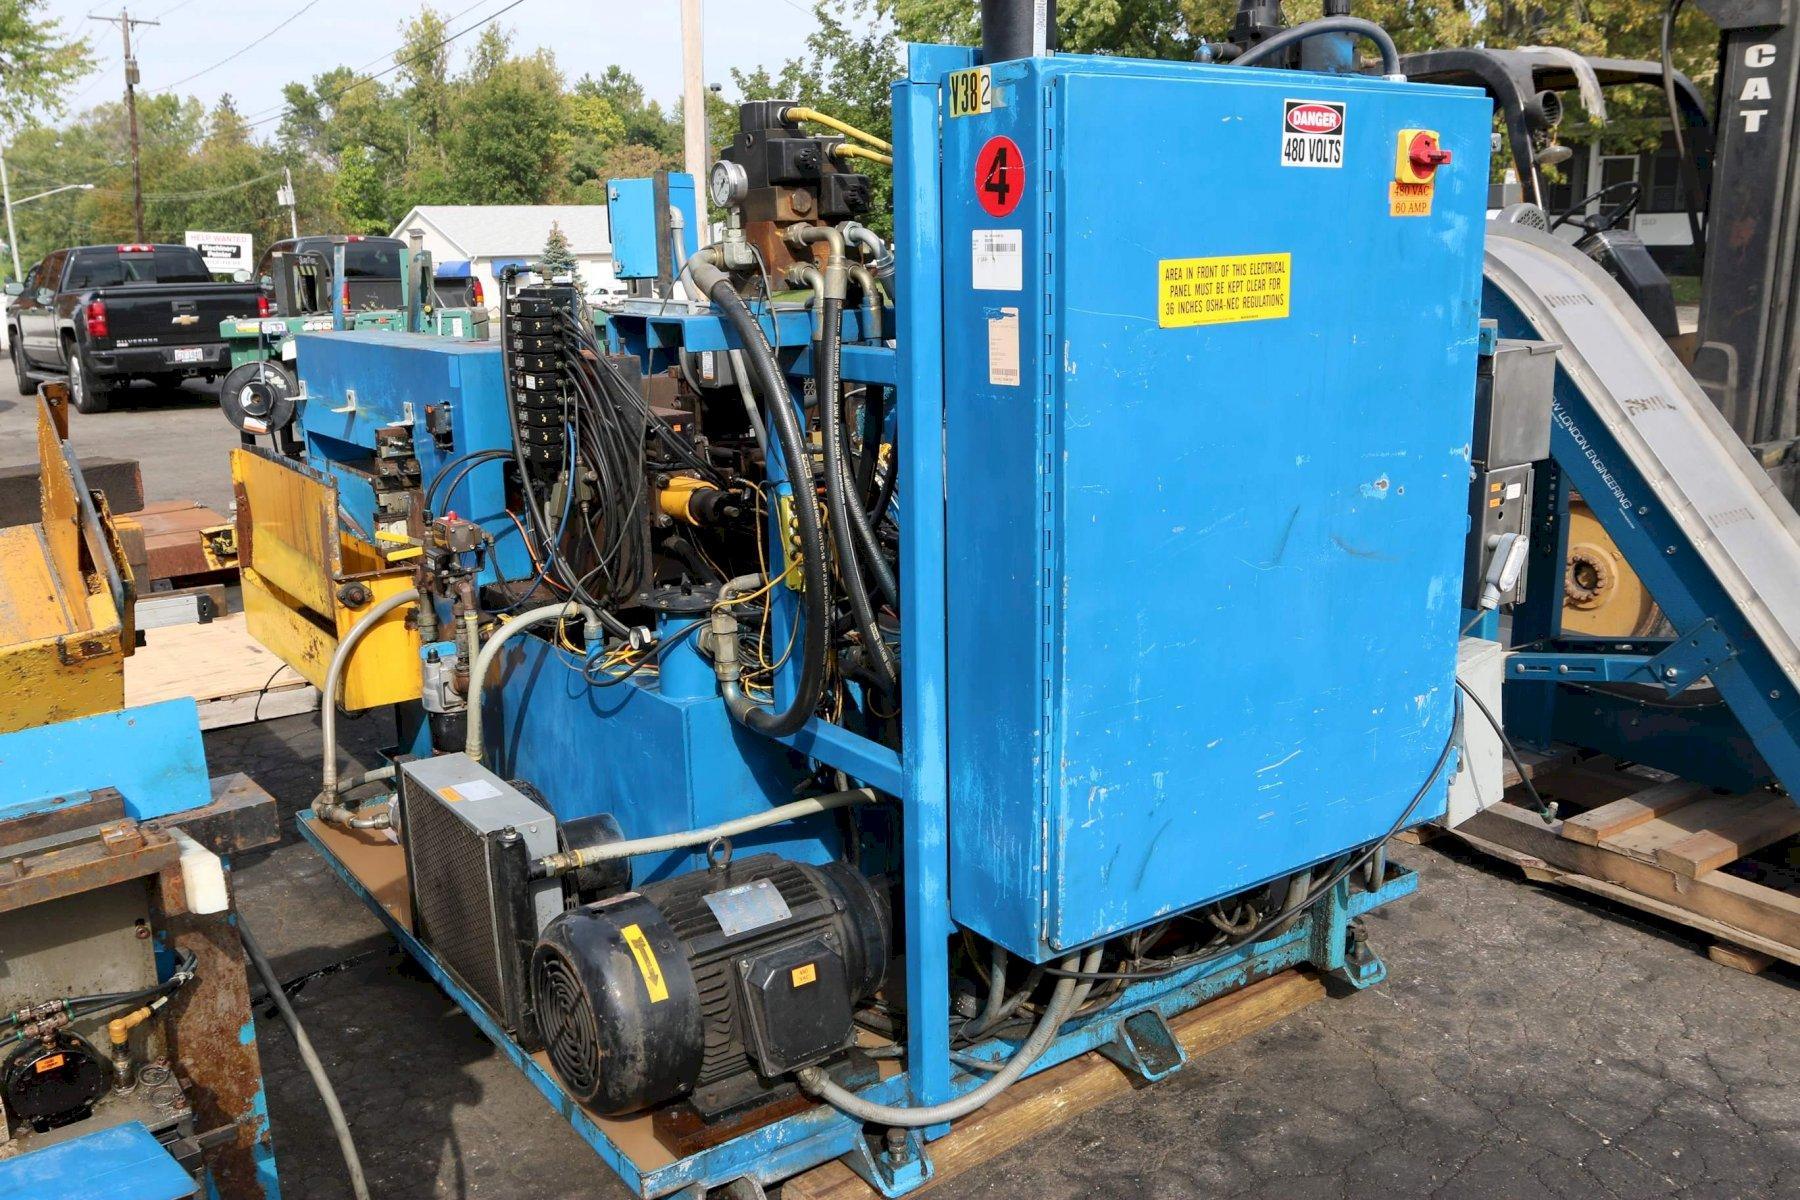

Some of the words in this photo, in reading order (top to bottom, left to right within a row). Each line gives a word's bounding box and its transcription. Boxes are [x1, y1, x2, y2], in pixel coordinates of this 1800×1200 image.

[951, 72, 991, 115] V382
[1740, 43, 1777, 133] CAT
[1293, 110, 1337, 128] DANGER
[1285, 138, 1305, 162] 480
[1309, 138, 1341, 163] VOLTS
[985, 147, 1010, 205] 4
[1394, 184, 1410, 197] 480
[1412, 184, 1430, 197] VAC
[1395, 202, 1407, 214] 60
[1408, 202, 1428, 214] AMP
[190, 234, 211, 242] HELP
[213, 235, 247, 243] WANTED
[1165, 268, 1183, 280] AREA
[1186, 266, 1194, 279] IN
[1197, 265, 1218, 278] FRONT
[1221, 264, 1230, 277] OF
[1233, 263, 1247, 276] THIS
[1250, 261, 1286, 275] ELECTRICAL
[1170, 284, 1191, 298] PANEL
[1195, 282, 1213, 296] MUST
[1216, 282, 1225, 294] BE
[1228, 280, 1244, 293] KEPT
[1246, 278, 1266, 292] CLEAR
[1269, 277, 1281, 290] FOR
[1165, 302, 1175, 315] 36
[1178, 300, 1203, 314] INCHES
[1206, 297, 1240, 312] OSHA-NEC
[1243, 294, 1284, 309] REGULATIONS
[834, 391, 838, 402] mm
[1560, 411, 1590, 450] LONDON
[1585, 449, 1632, 510] ENGINEERING
